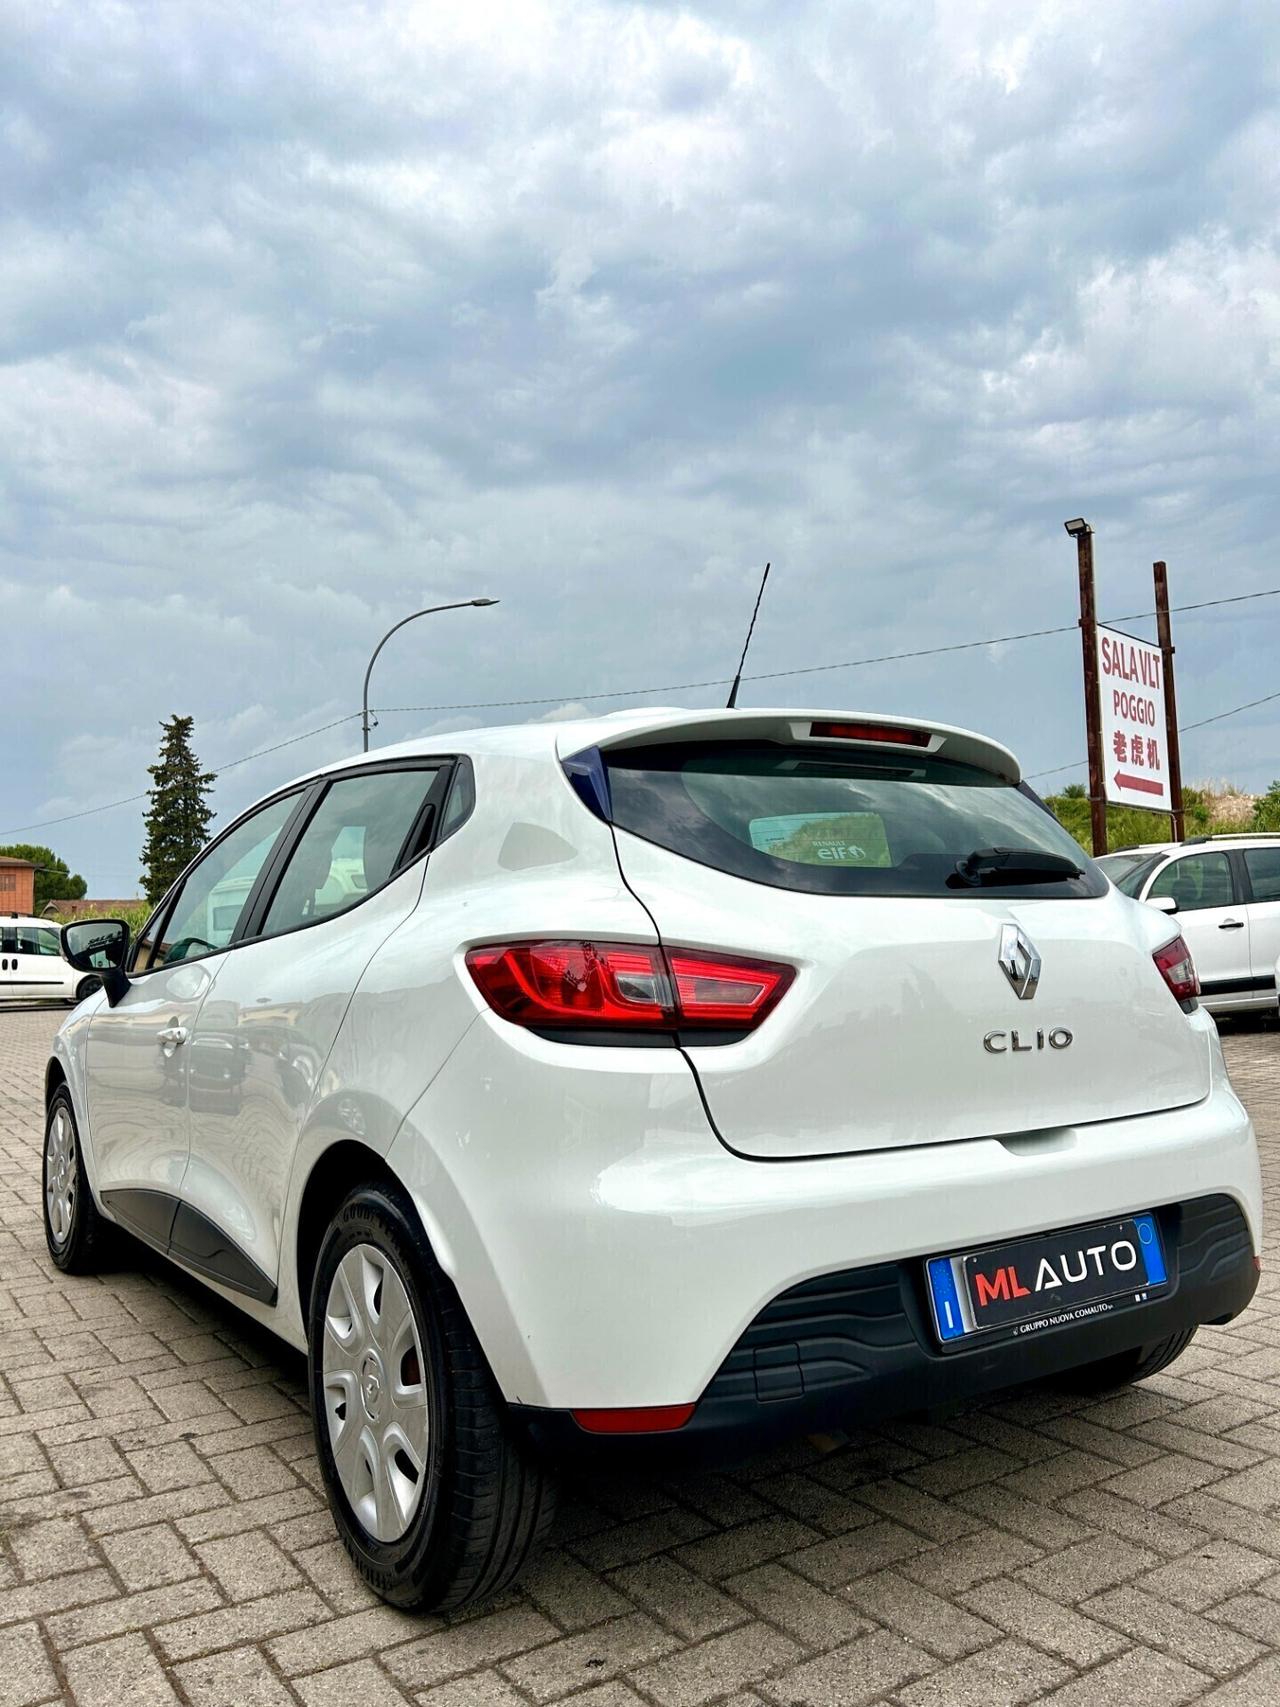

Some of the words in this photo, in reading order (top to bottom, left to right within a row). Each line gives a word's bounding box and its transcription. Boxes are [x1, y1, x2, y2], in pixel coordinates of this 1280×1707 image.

[1101, 636, 1139, 684] SALA
[1139, 649, 1161, 690] VLT
[1113, 689, 1156, 728] POGGIO
[1113, 730, 1161, 771] 老虎机
[983, 1027, 1073, 1054] CLIO
[975, 1265, 1031, 1307] ML
[1034, 1240, 1138, 1292] AUTO
[1020, 1319, 1049, 1334] GRUPPO
[1049, 1312, 1075, 1325] NUOVA
[1074, 1303, 1108, 1319] COMAUTO
